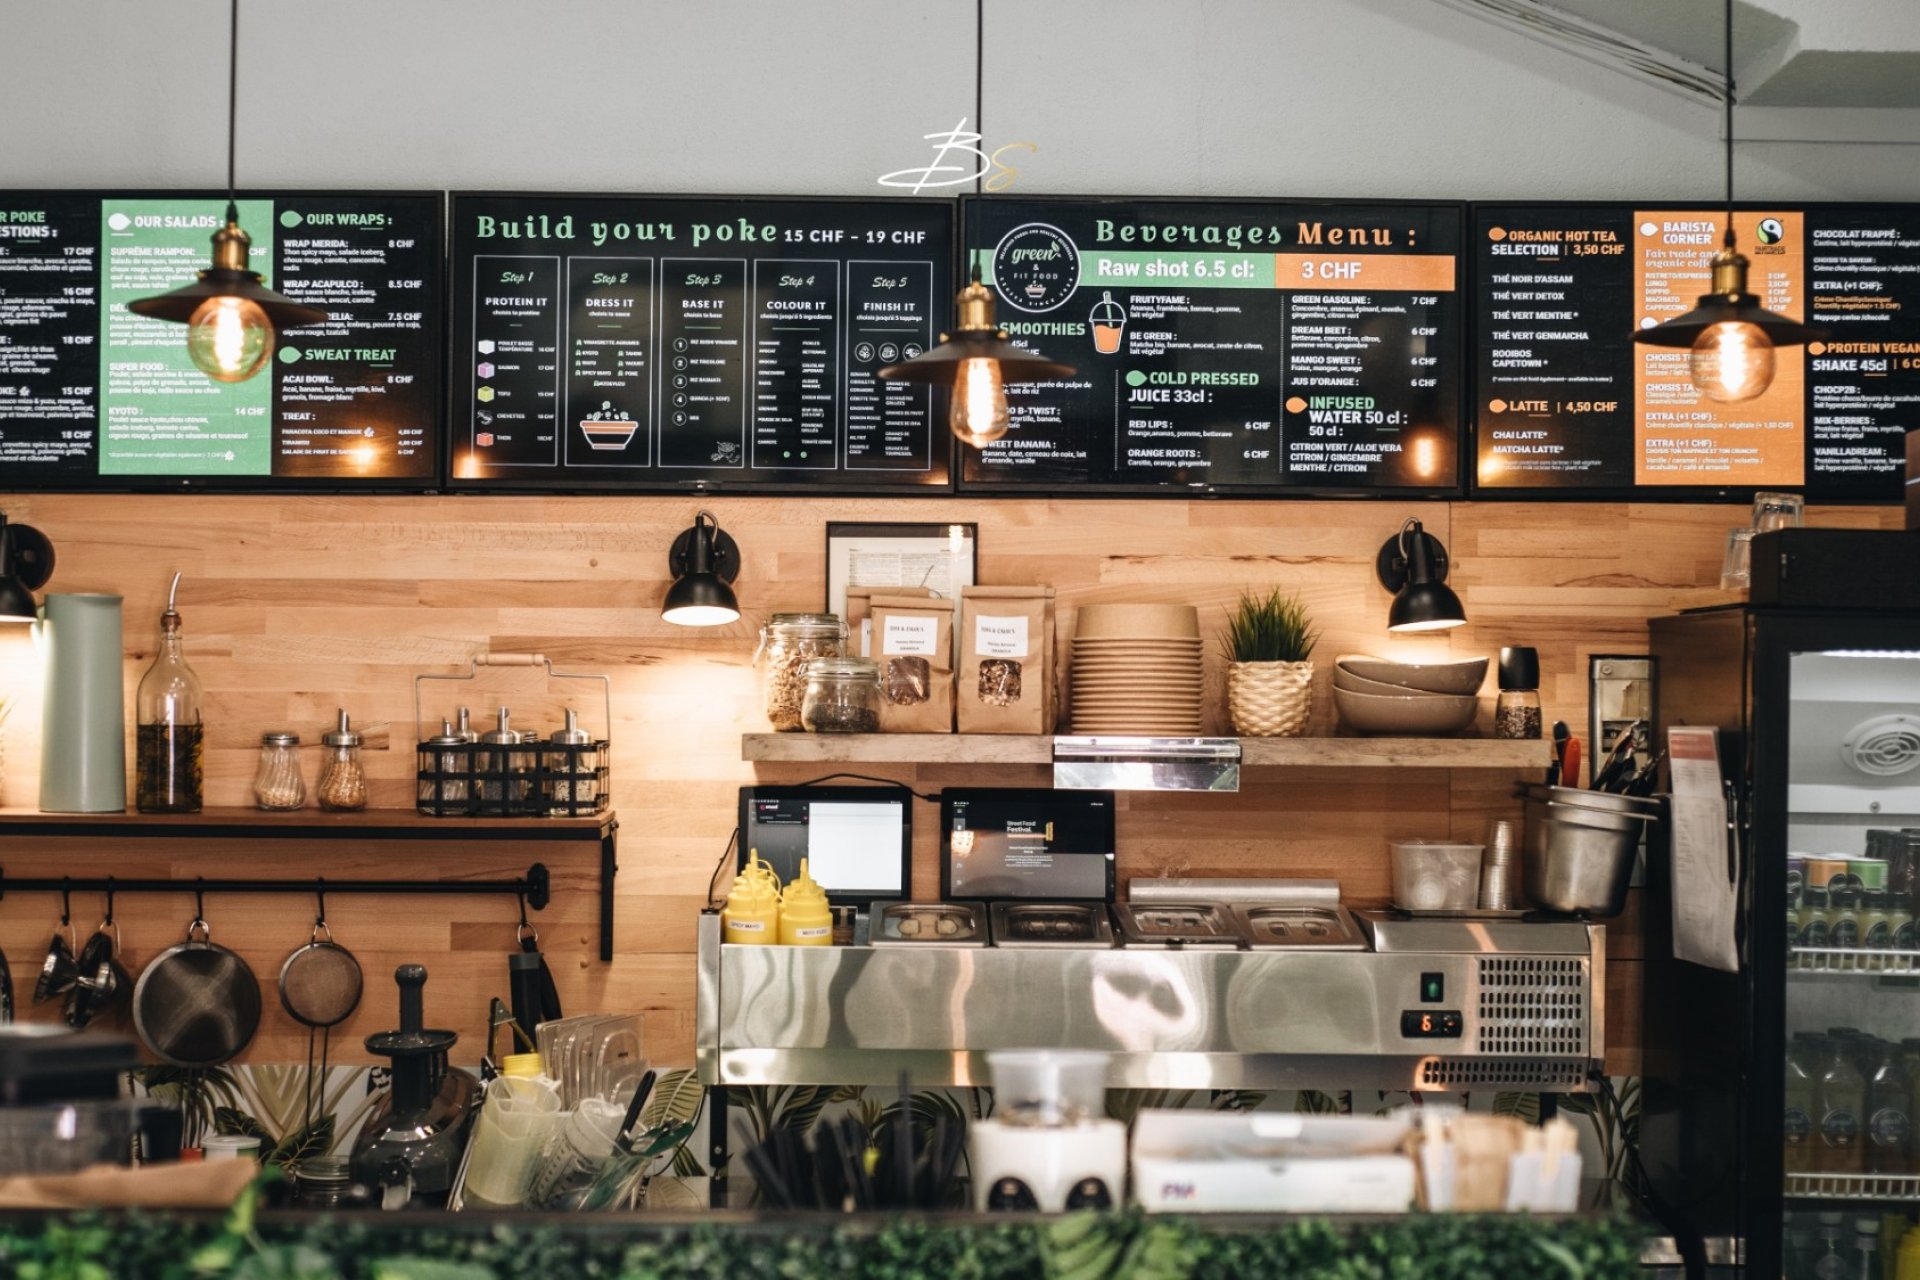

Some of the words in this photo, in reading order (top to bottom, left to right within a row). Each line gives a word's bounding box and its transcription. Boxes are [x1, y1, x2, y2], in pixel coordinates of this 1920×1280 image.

[10, 212, 45, 222] POKE
[135, 215, 162, 228] OUR
[164, 215, 216, 228] SALADS
[307, 214, 334, 225] OUR
[337, 214, 384, 225] WRAPS
[0, 226, 50, 237] STIONS
[477, 216, 575, 239] Build
[591, 222, 675, 246] your
[692, 218, 777, 247] poke
[784, 230, 804, 242] 15
[810, 230, 844, 242] CHF
[866, 231, 885, 243] 19
[891, 231, 926, 243] CHF
[1664, 222, 1715, 232] BARISTA
[1096, 220, 1282, 250] Beverages
[1297, 222, 1392, 245] Menu
[1509, 231, 1562, 242] ORGANIC
[1565, 231, 1590, 242] HOT
[1593, 231, 1616, 242] TEA
[1813, 229, 1860, 238] CHOCOLAT
[1861, 229, 1895, 238] FRAPPÉ
[284, 240, 310, 248] WRAP
[388, 240, 394, 248] 8
[397, 240, 414, 248] CHF
[1664, 234, 1712, 244] CORNER
[1492, 244, 1558, 255] SELECTION
[1574, 245, 1598, 256] 3,50
[1600, 245, 1625, 255] CHF
[1011, 249, 1057, 264] green
[1098, 259, 1139, 277] Raw
[1146, 259, 1189, 277] shot
[1195, 260, 1226, 278] 6.5
[1302, 262, 1314, 279] 3
[1320, 262, 1362, 279] CHF
[501, 272, 525, 284] Step
[592, 273, 617, 285] Step
[620, 273, 628, 283] 2
[685, 274, 709, 287] Step
[712, 274, 722, 285] 3
[779, 275, 803, 288] Step
[806, 276, 815, 286] 4
[872, 277, 896, 289] Step
[899, 277, 908, 288] 5
[1492, 274, 1510, 283] THÉ
[1512, 274, 1533, 283] NOIR
[1535, 274, 1573, 283] D'ASSAM
[284, 280, 310, 288] WRAP
[311, 280, 358, 288] ACAPULCO
[388, 280, 403, 288] 8.5
[404, 280, 422, 288] CHF
[1813, 282, 1842, 291] EXTRA
[1130, 296, 1186, 304] FRUITYFAME
[1292, 296, 1321, 305] GREEN
[1412, 297, 1417, 305] 7
[1419, 297, 1437, 305] CHF
[1492, 291, 1510, 300] THÉ
[1512, 291, 1534, 300] VERT
[1536, 291, 1564, 300] DETOX
[485, 298, 533, 306] PROTEIN
[537, 298, 548, 306] IT
[586, 299, 619, 307] DRESS
[623, 299, 634, 307] IT
[682, 301, 710, 309] BASE
[713, 301, 724, 309] IT
[767, 302, 811, 310] COLOUR
[816, 302, 826, 310] IT
[864, 303, 900, 311] FINISH
[904, 303, 915, 311] IT
[999, 322, 1086, 335] SMOOTHIES
[1292, 326, 1322, 336] DREAM
[1325, 326, 1346, 336] BEET
[1412, 326, 1417, 336] 6
[1419, 326, 1437, 336] CHF
[1130, 332, 1142, 340] BE
[1144, 332, 1172, 340] GREEN
[1492, 330, 1510, 340] THÉ
[1512, 330, 1534, 340] VERT
[1536, 330, 1589, 340] GENMAICHA
[1828, 343, 1880, 353] PROTEIN
[306, 349, 351, 360] SWEAT
[354, 349, 396, 360] TREAT
[1492, 350, 1532, 358] ROOIBOS
[1292, 356, 1325, 365] MANGO
[1326, 356, 1355, 365] SWEET
[1411, 356, 1417, 365] 6
[1419, 356, 1437, 365] CHF
[1492, 360, 1541, 368] CAPETOWN
[1812, 360, 1857, 371] SHAKE
[1860, 359, 1887, 371] 45cl
[1902, 358, 1910, 369] 6
[110, 363, 138, 371] SUPER
[140, 363, 164, 371] FOOD
[1150, 372, 1187, 385] COLD
[1192, 372, 1259, 386] PRESSED
[1129, 390, 1170, 403] JUICE
[1174, 390, 1205, 403] 33cl
[1310, 397, 1374, 410] INFUSED
[1510, 401, 1548, 412] LATTE
[1566, 402, 1591, 414] 4,50
[1594, 402, 1618, 412] CHF
[109, 407, 138, 415] KYOTO
[1310, 412, 1362, 424] WATER
[1365, 412, 1384, 424] 50
[1387, 412, 1400, 424] cl
[1130, 421, 1146, 430] RED
[1148, 421, 1168, 430] LIPS
[1245, 422, 1251, 430] 6
[1253, 422, 1271, 430] CHF
[1291, 443, 1323, 452] CITRON
[1325, 443, 1348, 452] VERT
[1355, 443, 1377, 452] ALOE
[1379, 443, 1402, 452] VERA
[1128, 450, 1164, 458] ORANGE
[1166, 450, 1195, 458] ROOTS
[1244, 450, 1249, 458] 6
[1251, 450, 1270, 458] CHF
[1291, 454, 1323, 462] CITRON
[1331, 454, 1382, 462] GINGEMBRE
[1291, 464, 1327, 472] MENTHE
[1334, 464, 1367, 472] CITRON
